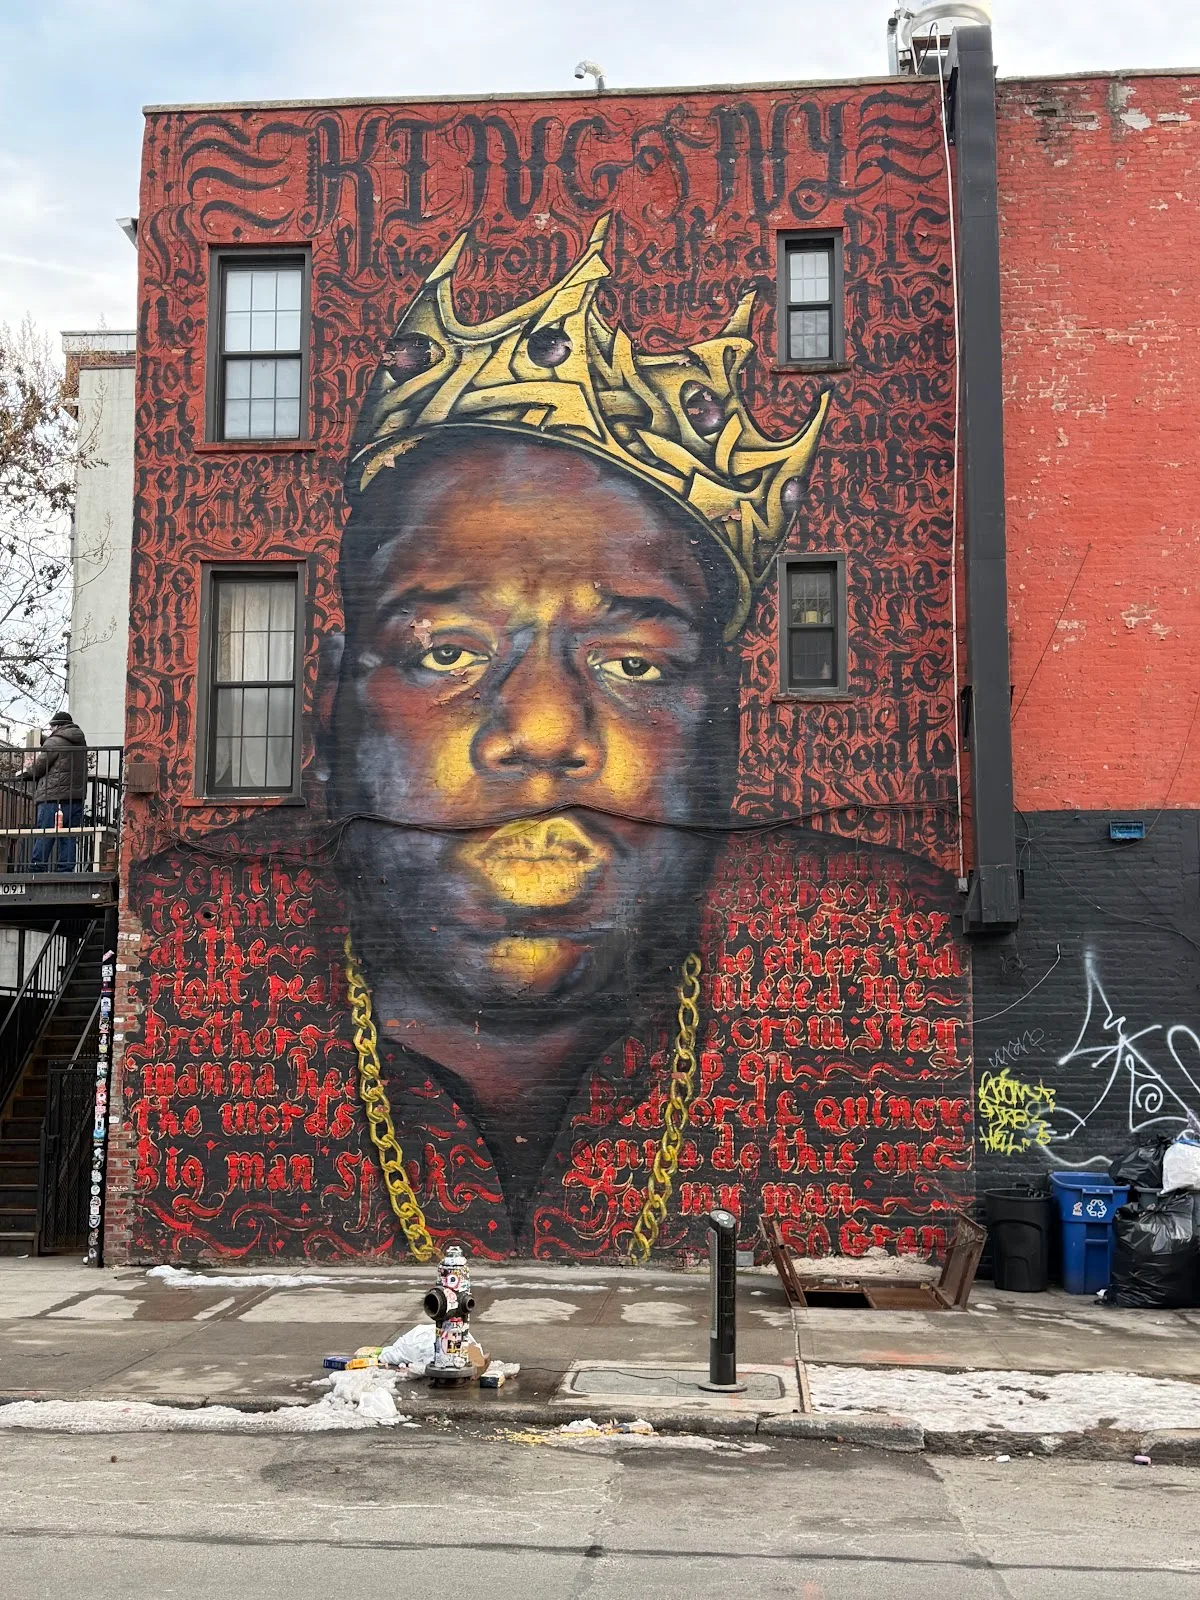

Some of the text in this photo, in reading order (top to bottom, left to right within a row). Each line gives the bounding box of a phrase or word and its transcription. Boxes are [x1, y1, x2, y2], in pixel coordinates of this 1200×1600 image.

[183, 860, 322, 898] on the
[149, 925, 268, 970] at the
[762, 935, 880, 978] others
[148, 963, 248, 1020] right
[144, 1007, 320, 1061] Brothers
[730, 1014, 850, 1050] crew
[140, 1062, 278, 1100] wanna
[219, 1092, 359, 1140] words
[814, 1088, 972, 1136] Quincy
[225, 1150, 318, 1198] man
[769, 1128, 860, 1176] this
[872, 1142, 946, 1178] one
[762, 1182, 854, 1218] man
